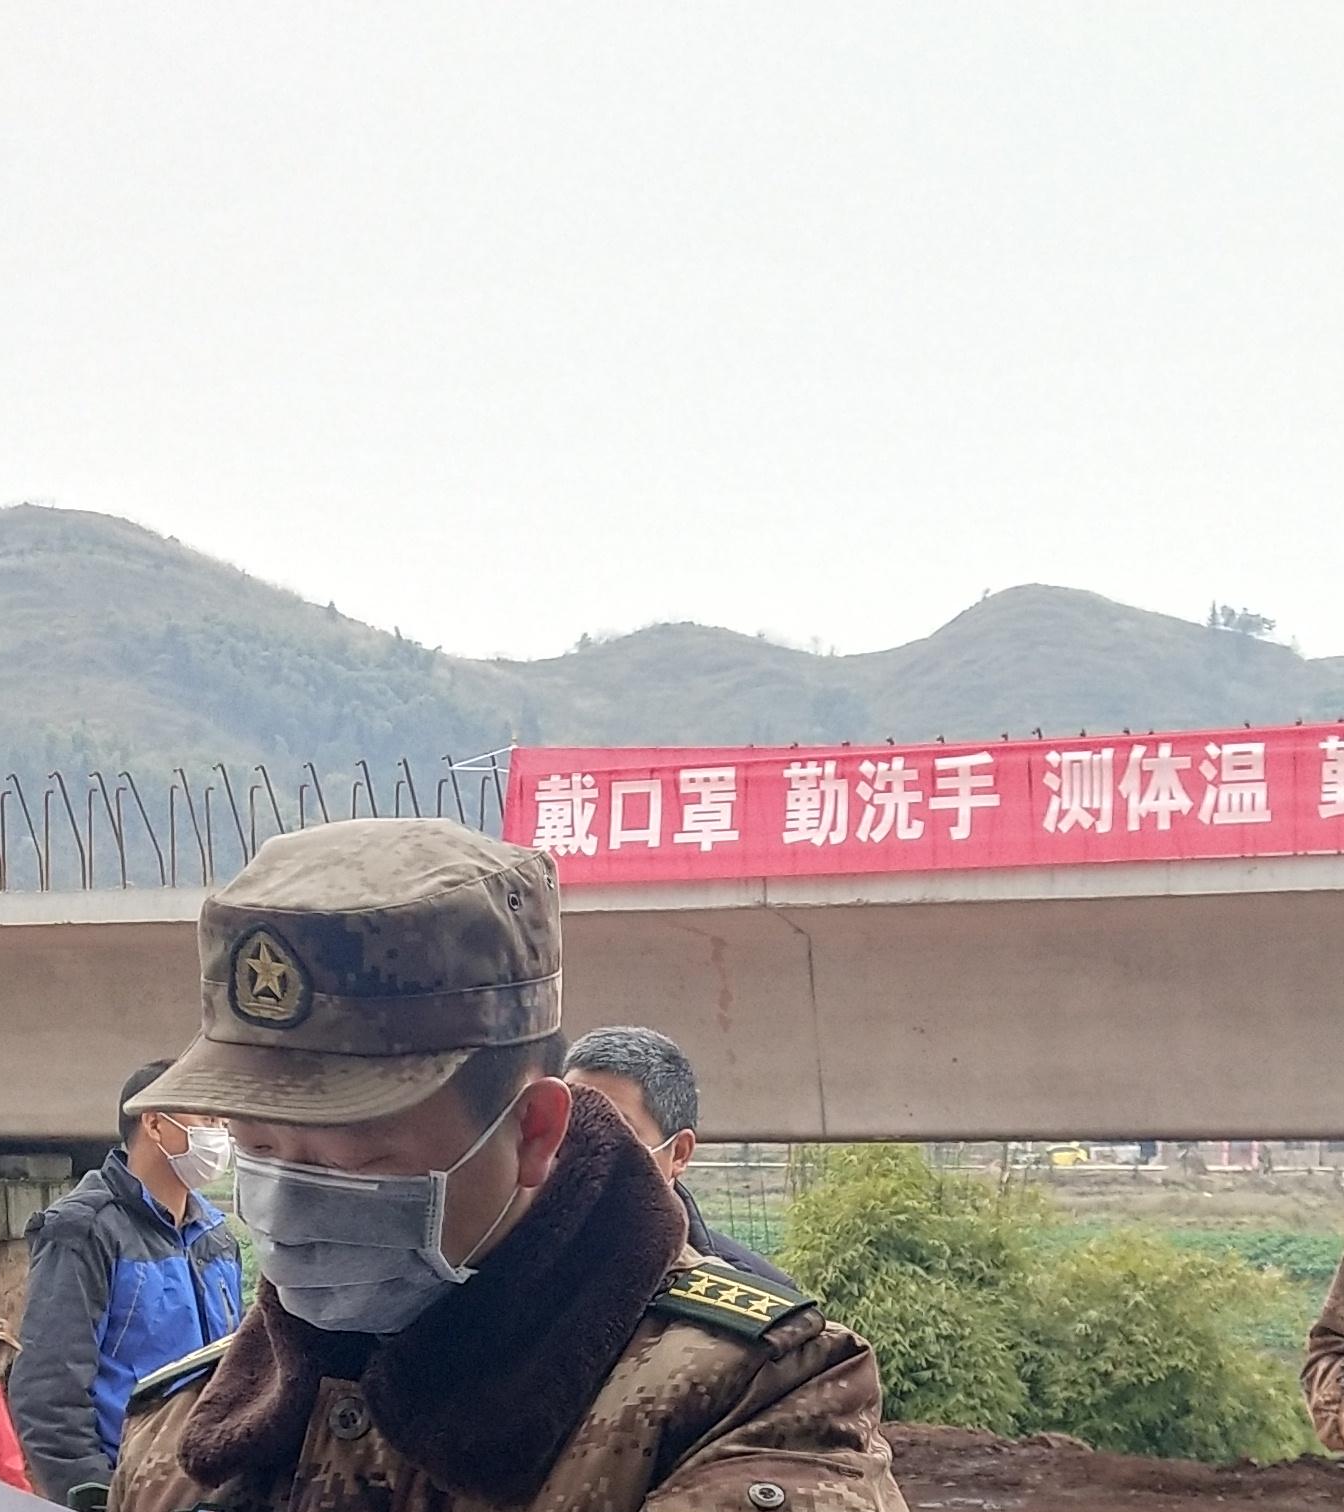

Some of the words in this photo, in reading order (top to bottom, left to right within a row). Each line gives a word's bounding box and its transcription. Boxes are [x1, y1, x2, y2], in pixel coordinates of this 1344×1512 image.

[533, 766, 740, 857] 戴口罩
[783, 751, 1001, 848] 勤洗手
[1042, 741, 1271, 834] 测体温
